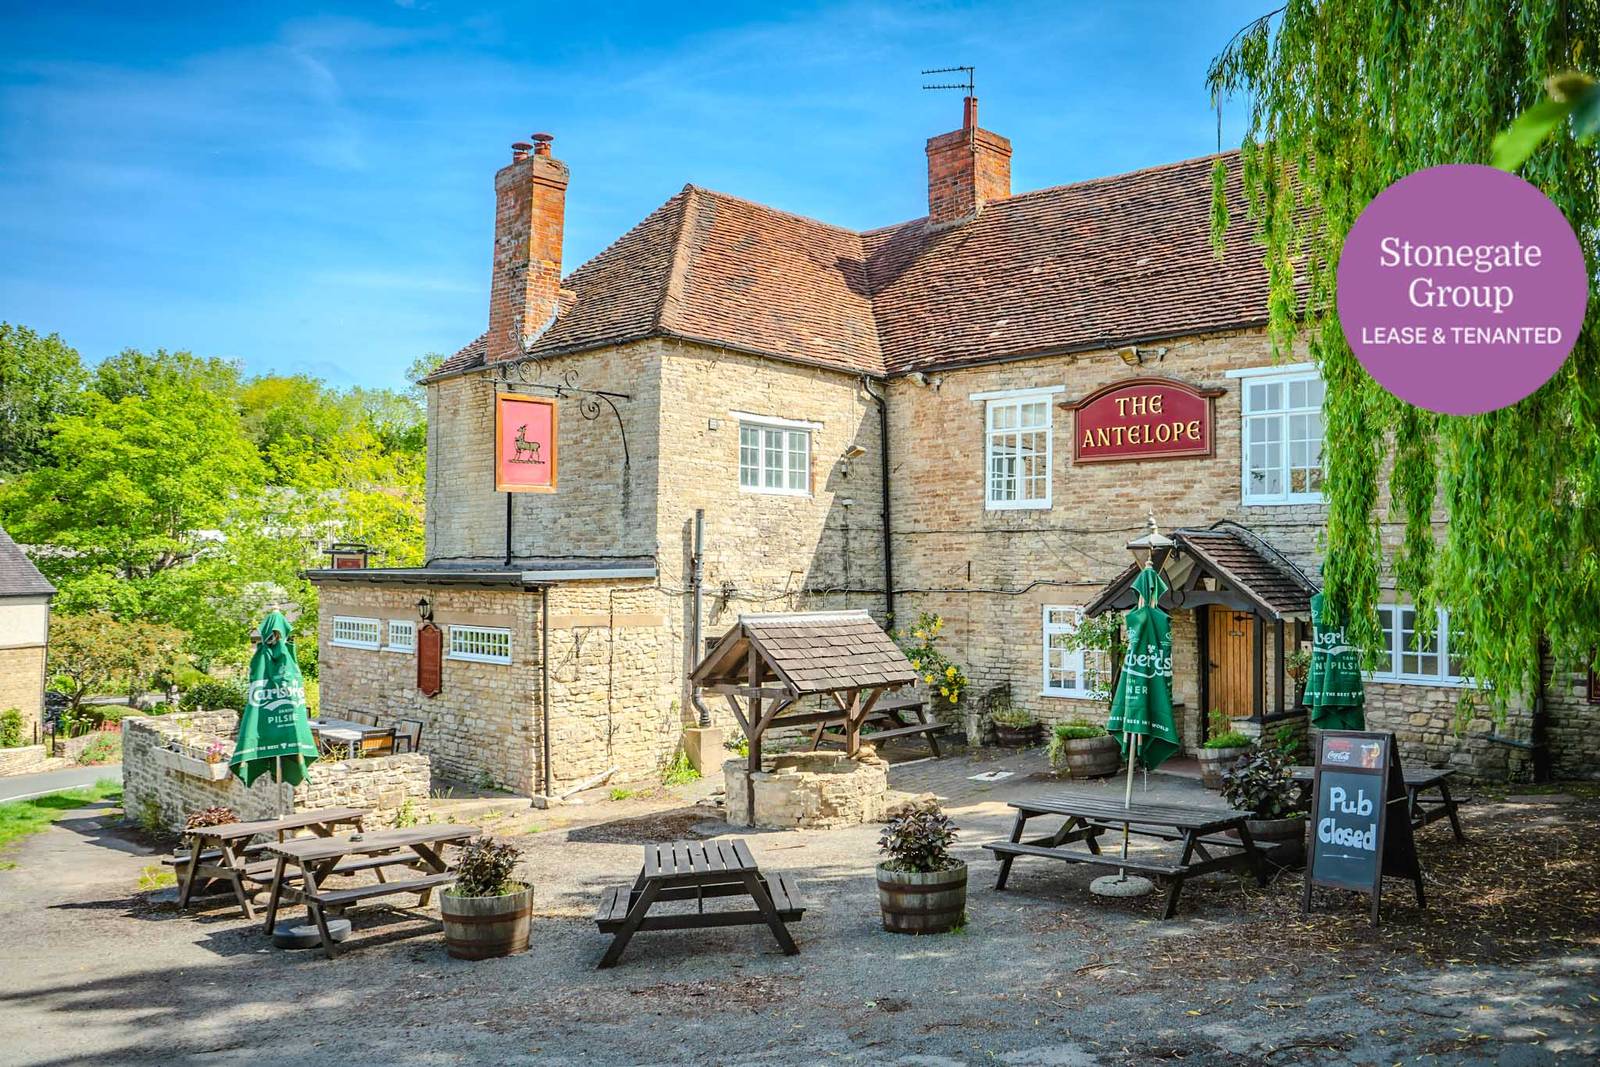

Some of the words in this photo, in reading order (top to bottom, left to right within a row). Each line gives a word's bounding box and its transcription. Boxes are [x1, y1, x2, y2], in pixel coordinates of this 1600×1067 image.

[1115, 394, 1163, 417] THE
[1082, 420, 1201, 448] ANTELOPE
[1329, 786, 1373, 816] Pub
[1318, 817, 1377, 852] Closed
